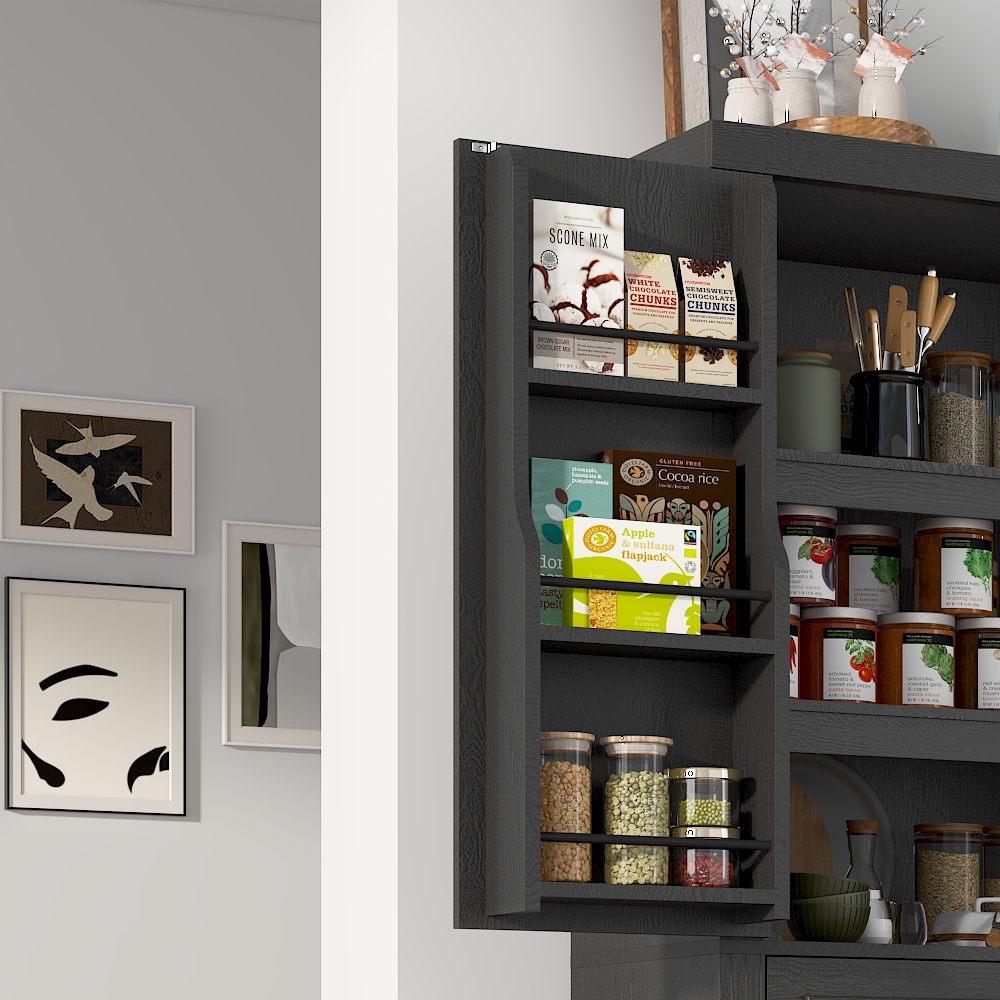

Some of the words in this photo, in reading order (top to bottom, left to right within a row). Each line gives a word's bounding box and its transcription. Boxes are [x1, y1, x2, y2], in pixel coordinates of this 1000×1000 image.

[549, 228, 585, 247] SCONE
[589, 232, 609, 249] MIX
[628, 278, 661, 288] WHITE
[629, 286, 676, 296] CHOCOLATE
[685, 286, 734, 295] SEMISWEET
[630, 293, 677, 306] CHUNKS
[686, 293, 735, 302] CHOCOLATE
[687, 300, 736, 312] CHUNKS
[537, 336, 554, 344] BROWN
[536, 344, 562, 352] CHOCOLATE
[622, 460, 638, 473] DOVES
[638, 460, 651, 474] FARM
[659, 458, 684, 466] GLUTEN
[623, 474, 650, 485] ORGANIC
[658, 468, 695, 483] Cocoa
[698, 472, 720, 485] rice
[585, 526, 599, 543] DOVES
[600, 526, 615, 540] FARM
[621, 527, 655, 540] Apple
[587, 541, 615, 552] ORGANIC
[621, 539, 630, 548] &
[633, 540, 676, 551] sultana
[621, 550, 667, 563] flapjack
